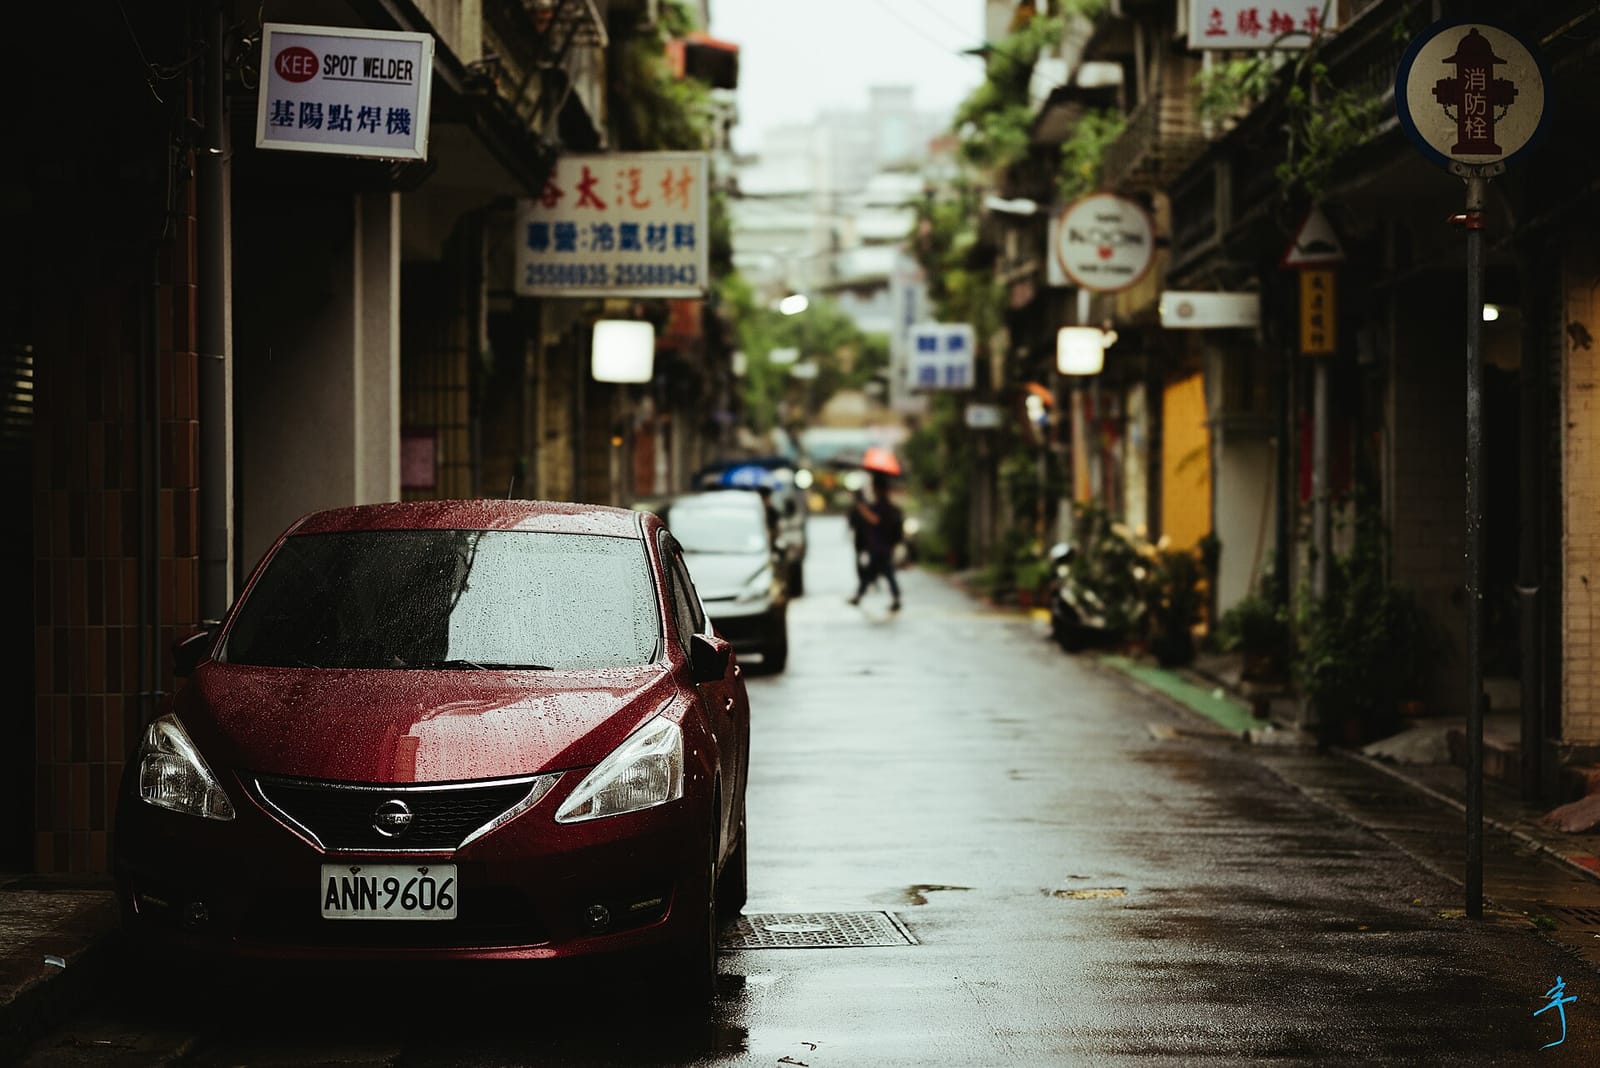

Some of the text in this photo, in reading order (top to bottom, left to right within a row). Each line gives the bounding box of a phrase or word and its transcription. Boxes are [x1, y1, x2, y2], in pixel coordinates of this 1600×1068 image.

[280, 54, 413, 81] KEE SPOT WELDER
[270, 99, 412, 135] 基陽點焊機
[1464, 67, 1488, 139] 消防栓
